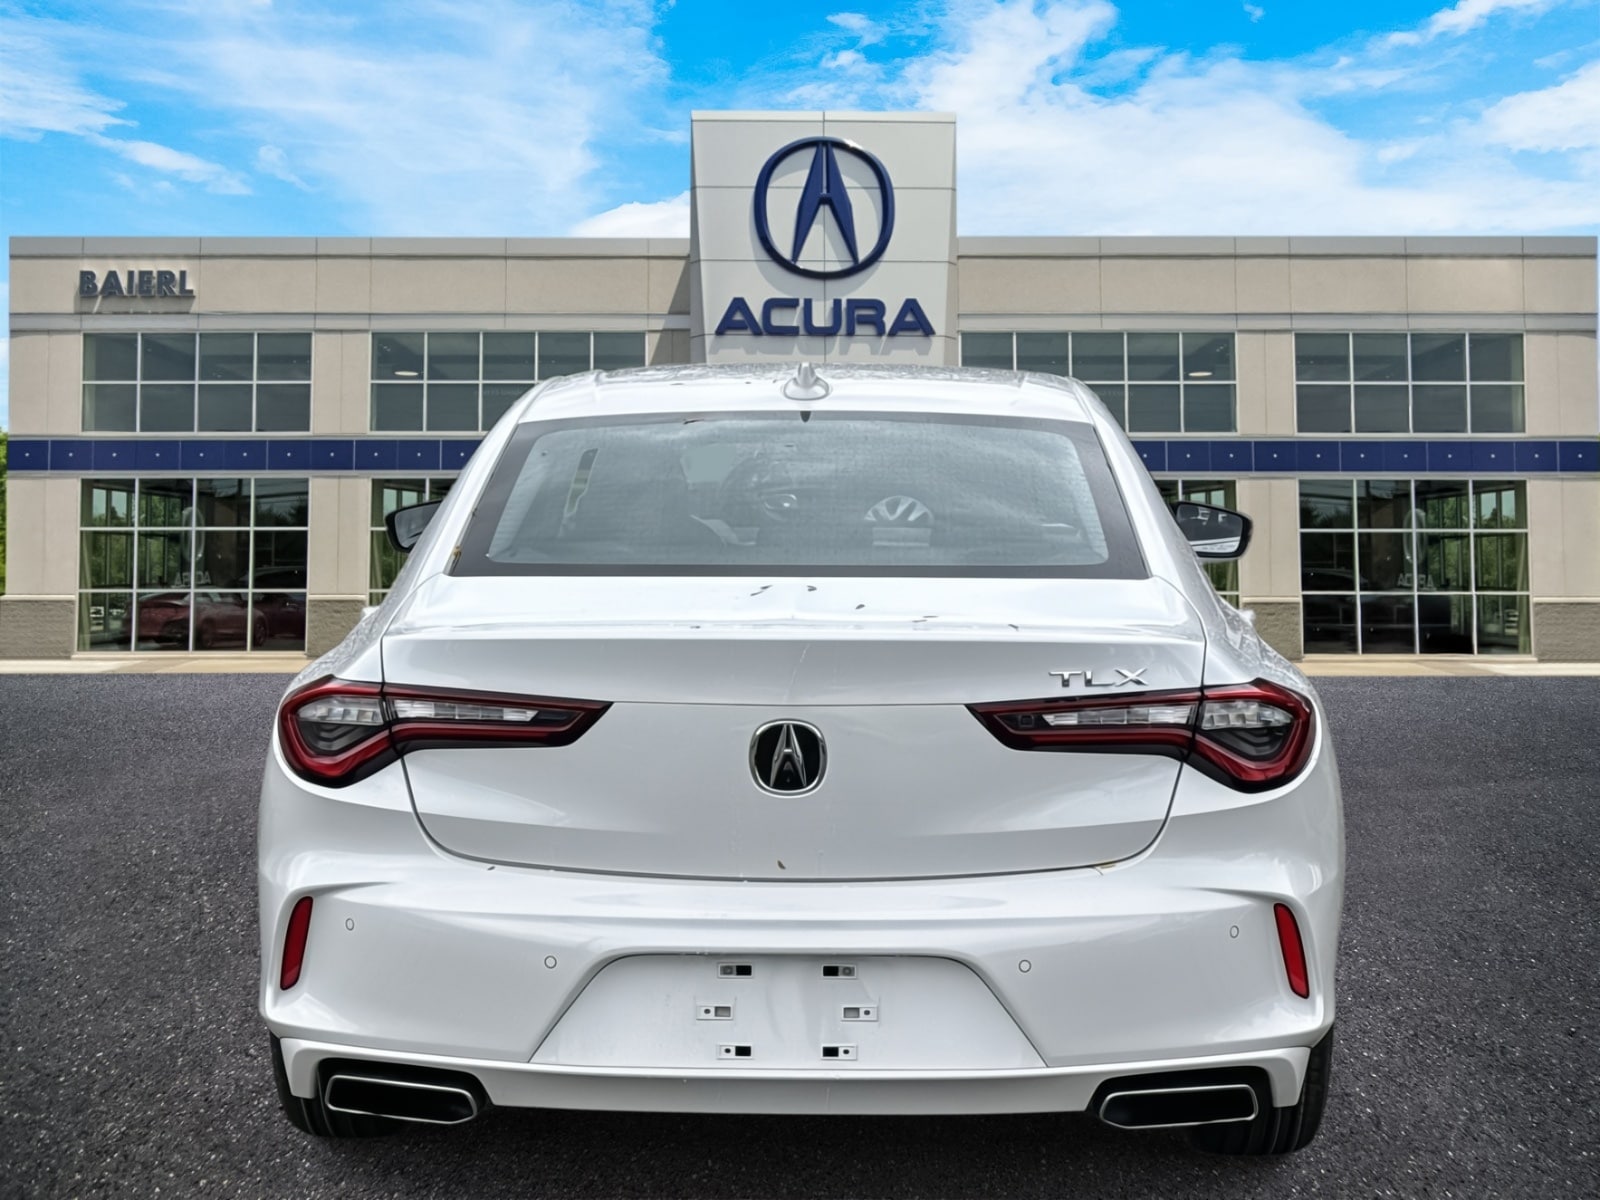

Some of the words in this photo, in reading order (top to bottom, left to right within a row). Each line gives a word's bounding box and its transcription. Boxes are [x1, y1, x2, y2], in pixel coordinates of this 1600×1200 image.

[79, 269, 195, 297] BAIERL
[715, 297, 936, 337] ACURA
[1397, 572, 1434, 588] ACRA
[1048, 667, 1149, 688] TLX
